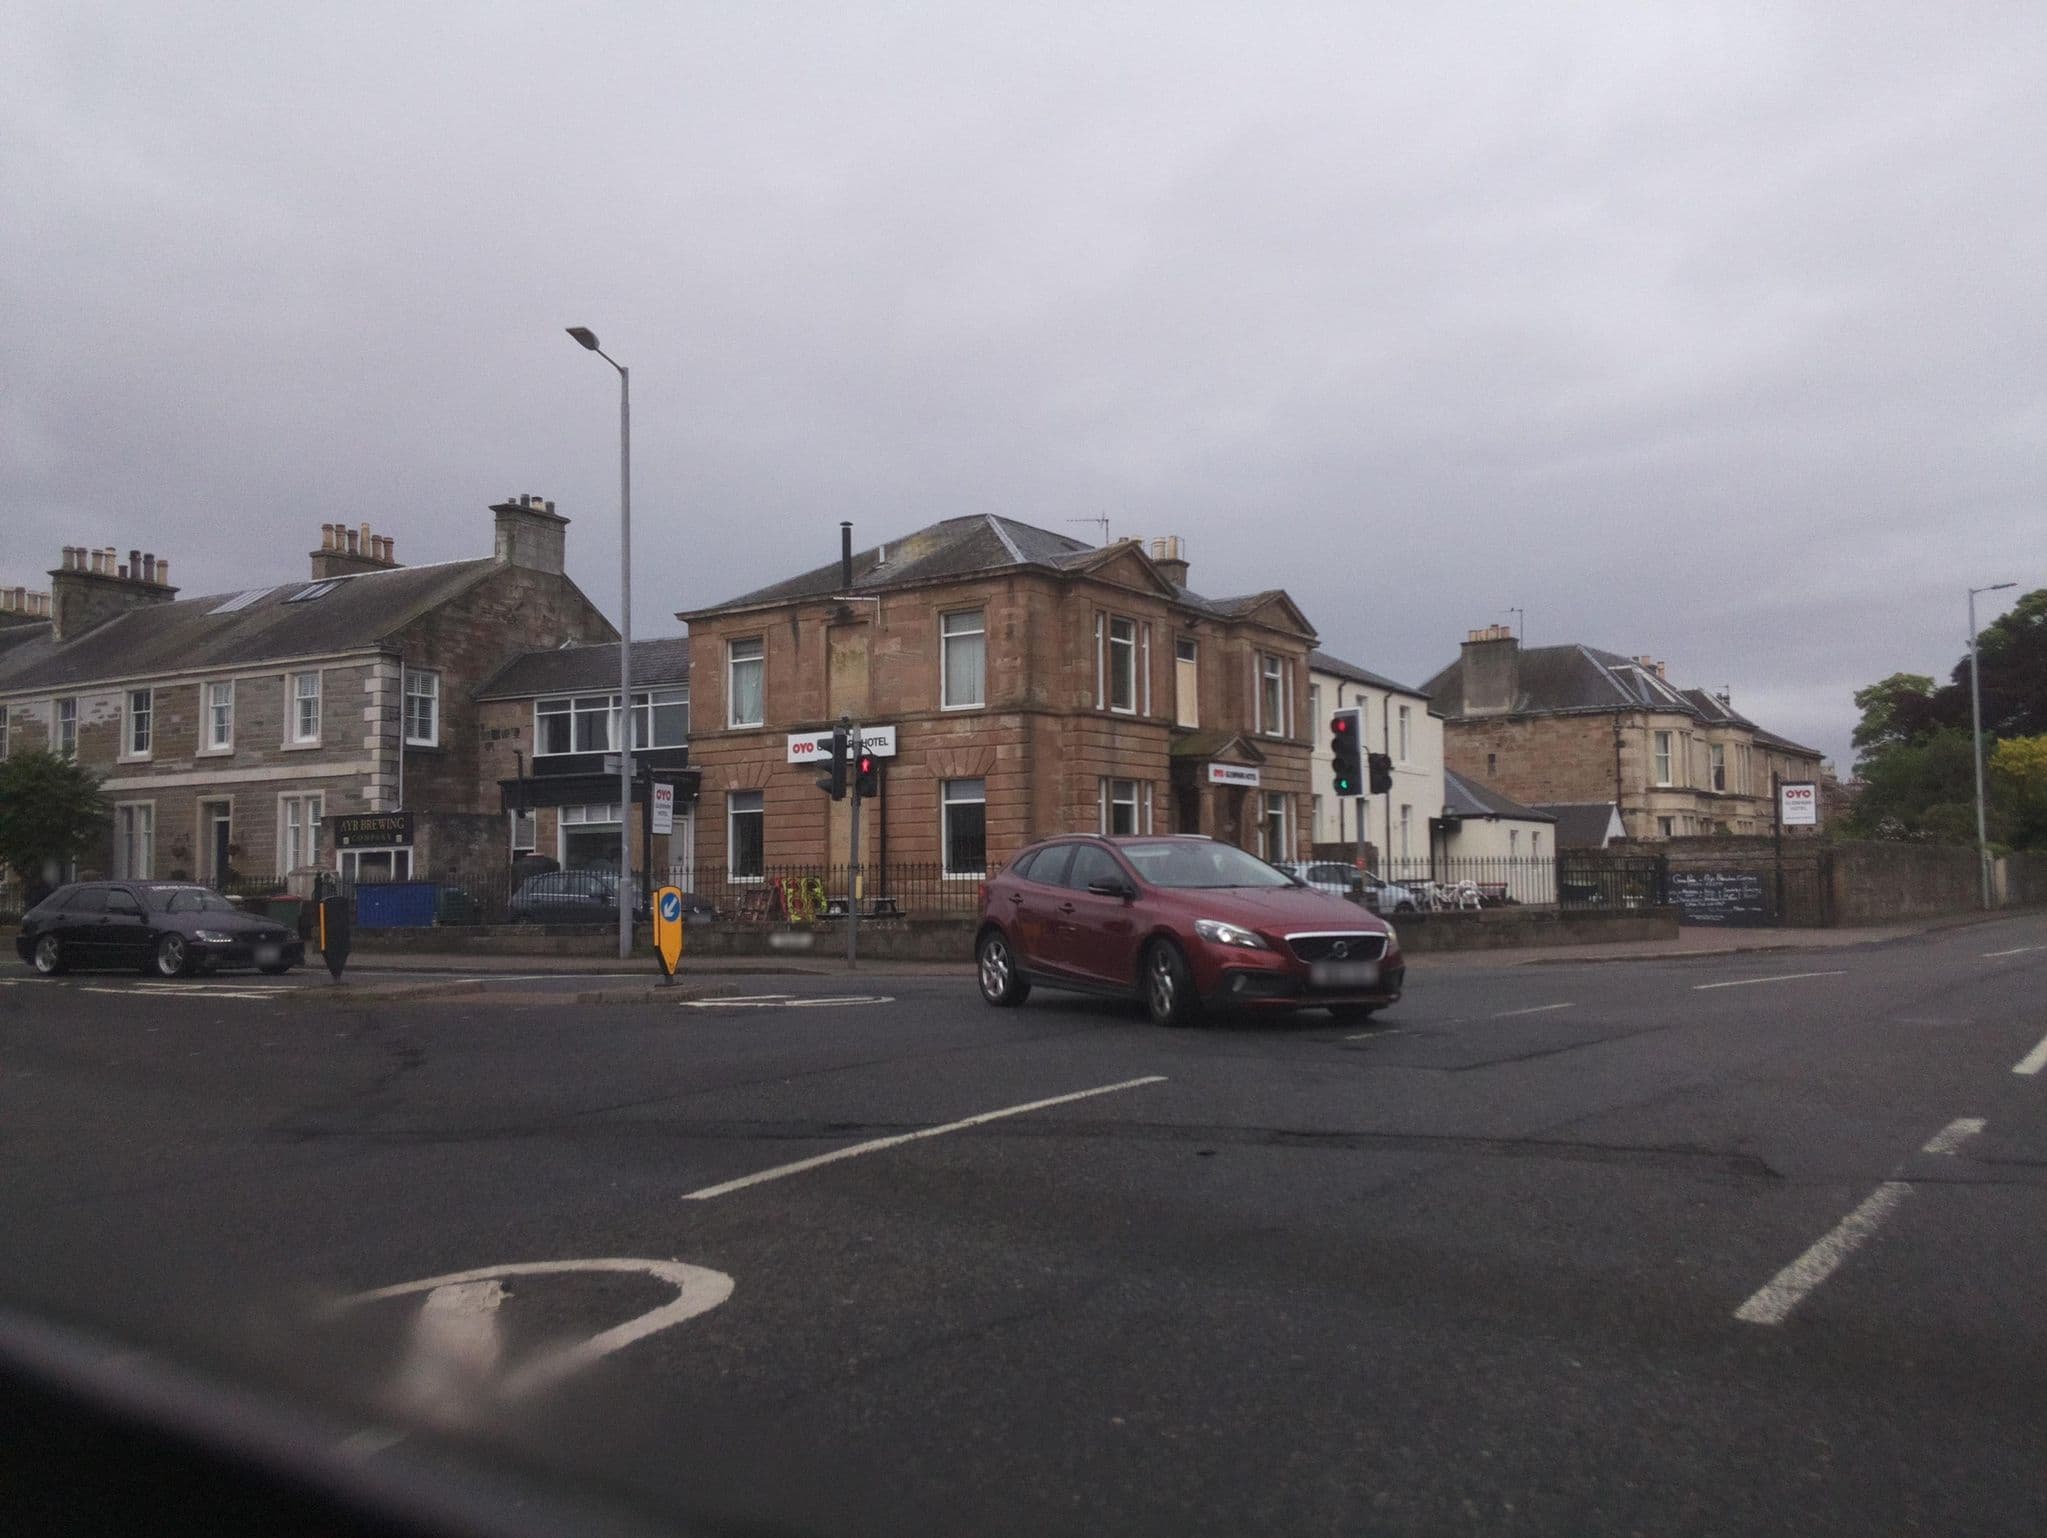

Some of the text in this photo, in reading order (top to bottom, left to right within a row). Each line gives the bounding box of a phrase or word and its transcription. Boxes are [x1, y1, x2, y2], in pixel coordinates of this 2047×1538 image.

[793, 742, 814, 753] OYO
[862, 737, 888, 748] HOTEL
[656, 789, 671, 801] OYO
[1786, 790, 1811, 799] OYO
[342, 817, 405, 832] AYR BREWING
